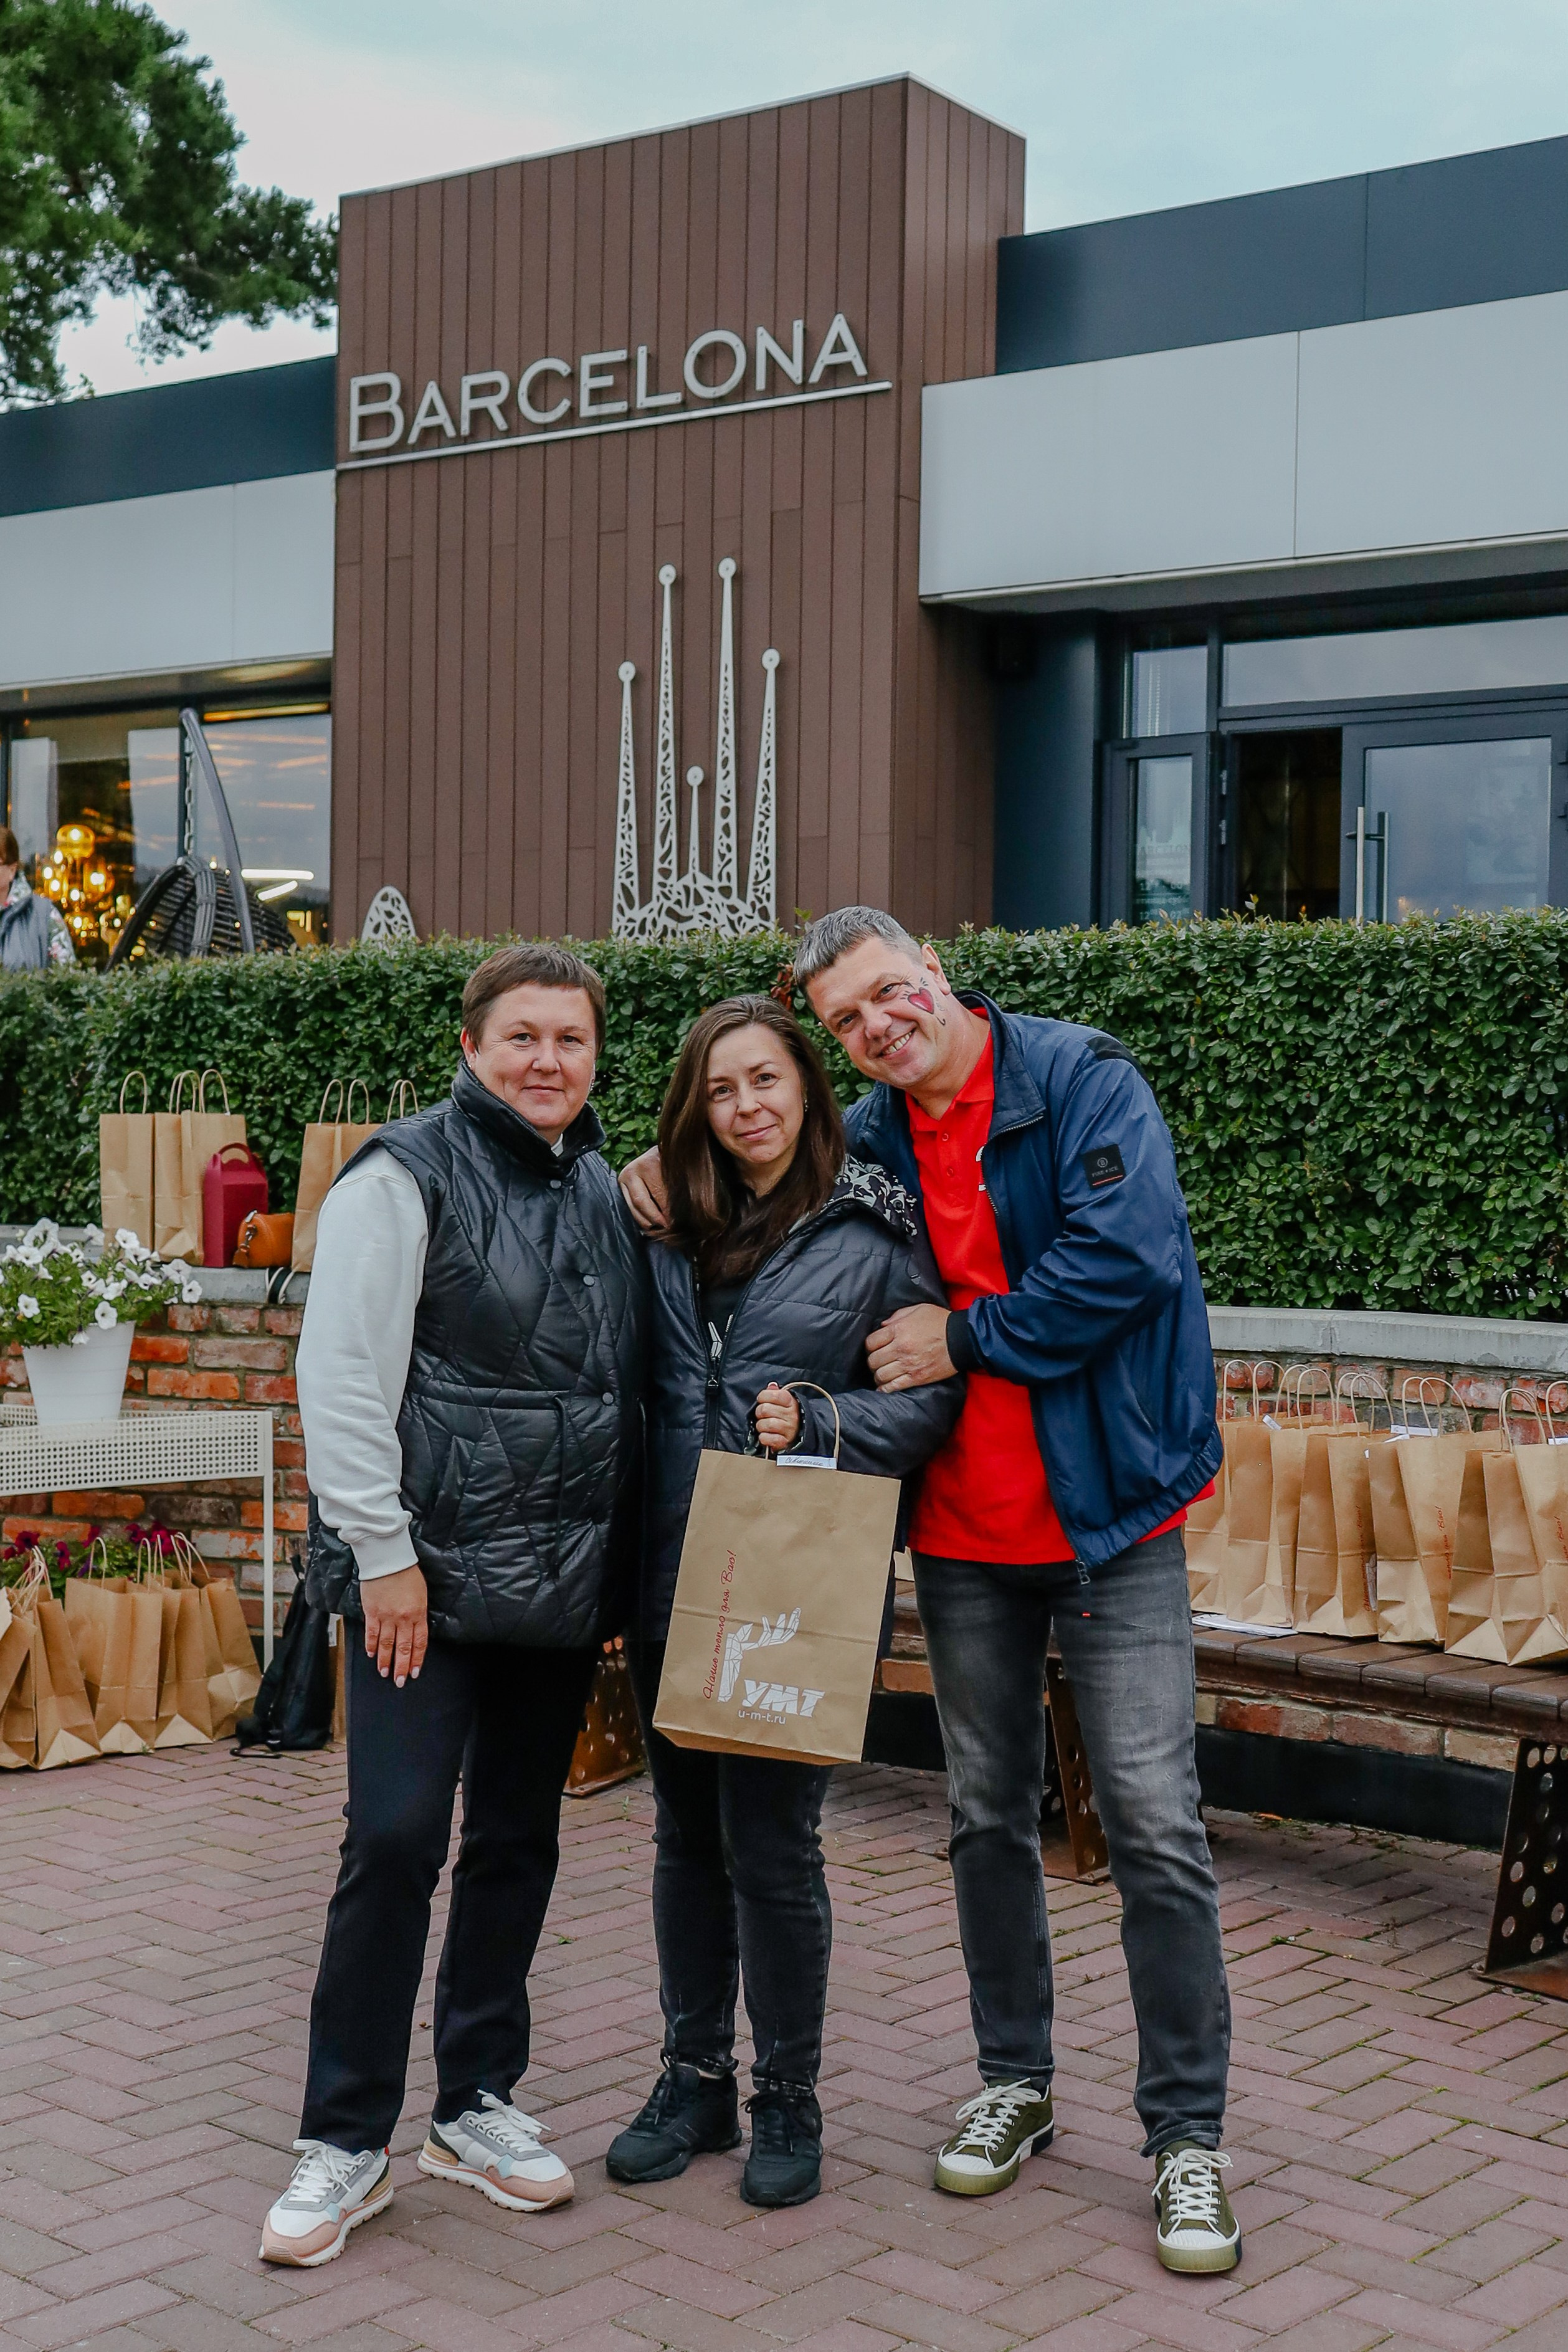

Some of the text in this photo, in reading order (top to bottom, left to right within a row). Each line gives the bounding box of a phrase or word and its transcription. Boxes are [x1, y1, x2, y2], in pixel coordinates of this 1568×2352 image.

[349, 312, 868, 454] BARCELONA
[720, 1549, 736, 1585] Вас!
[721, 1589, 730, 1614] для
[713, 1615, 726, 1655] тепло
[738, 1709, 786, 1725] u-m-t.ru
[741, 1678, 825, 1718] УМТ
